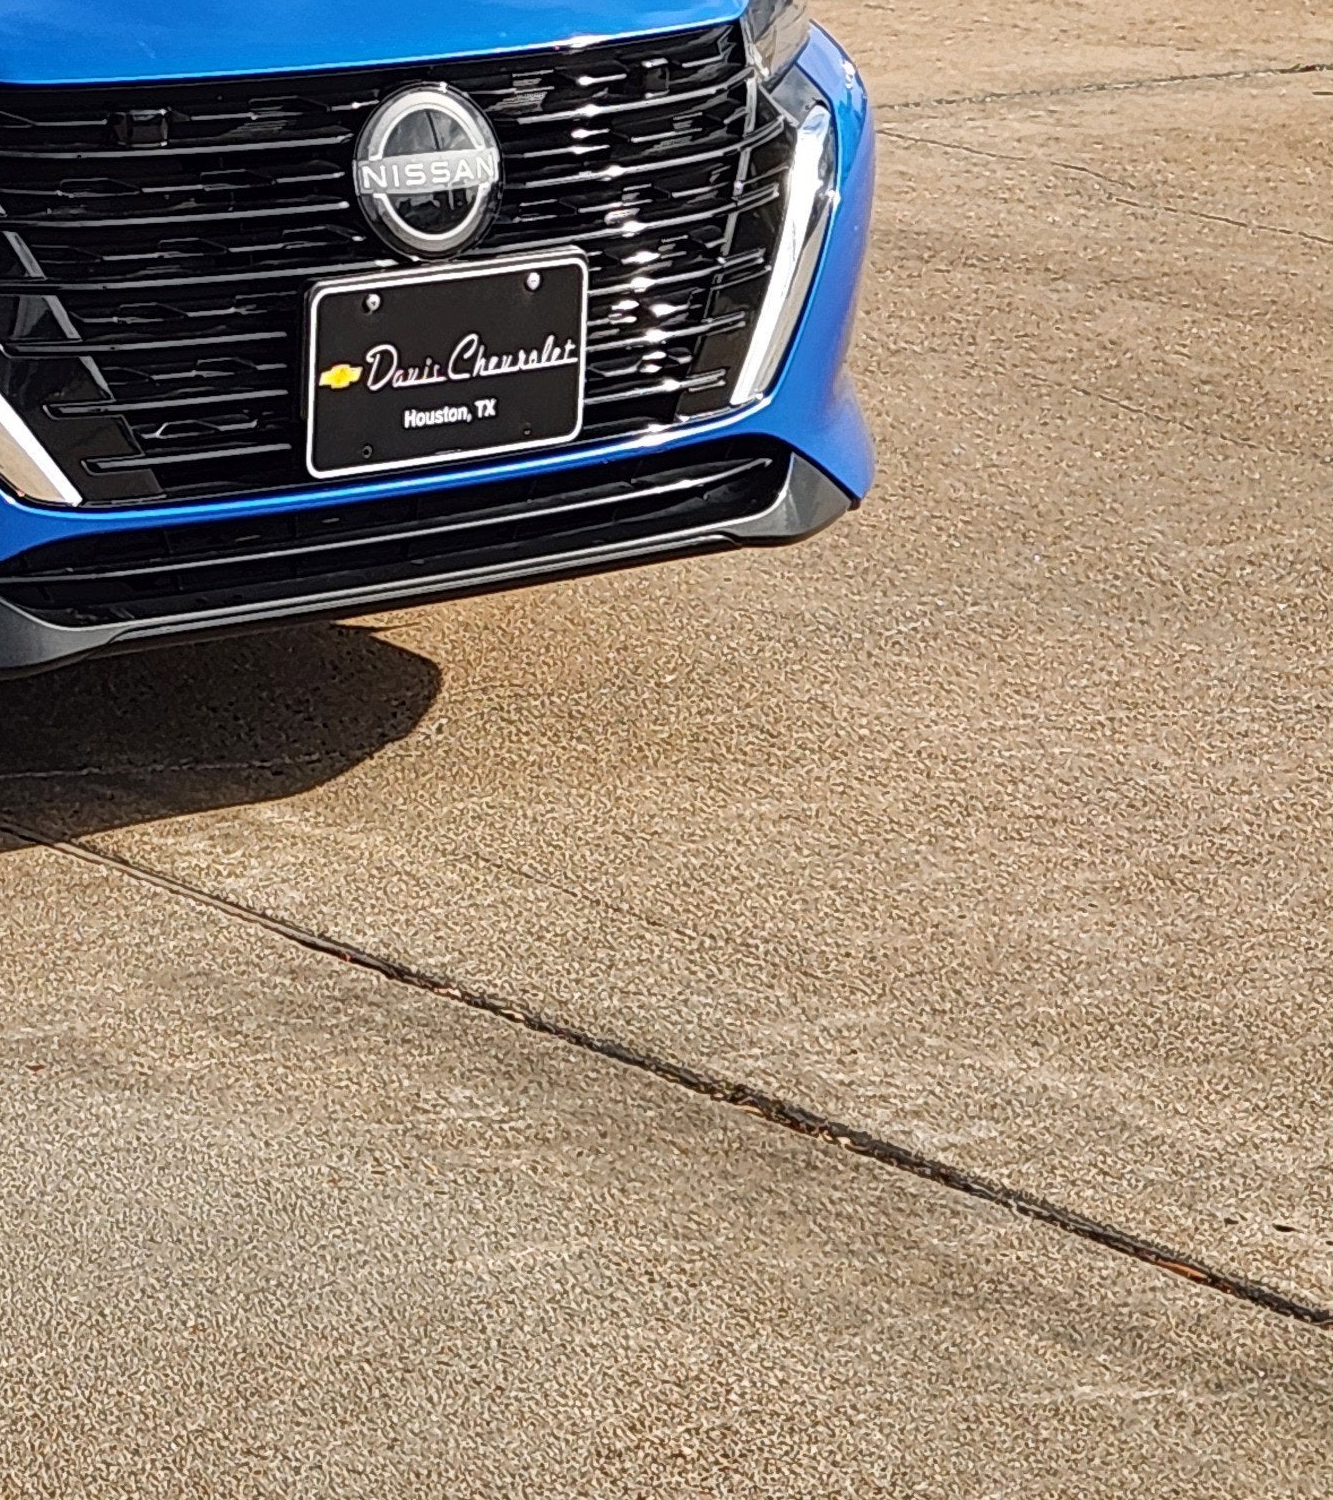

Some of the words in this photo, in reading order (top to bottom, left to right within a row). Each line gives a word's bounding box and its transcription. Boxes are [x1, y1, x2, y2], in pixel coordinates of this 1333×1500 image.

[361, 153, 495, 189] NISSAN
[366, 344, 447, 392] Davis
[447, 333, 579, 379] Chevrolet
[403, 406, 473, 429] Houston,
[474, 397, 498, 419] TX
